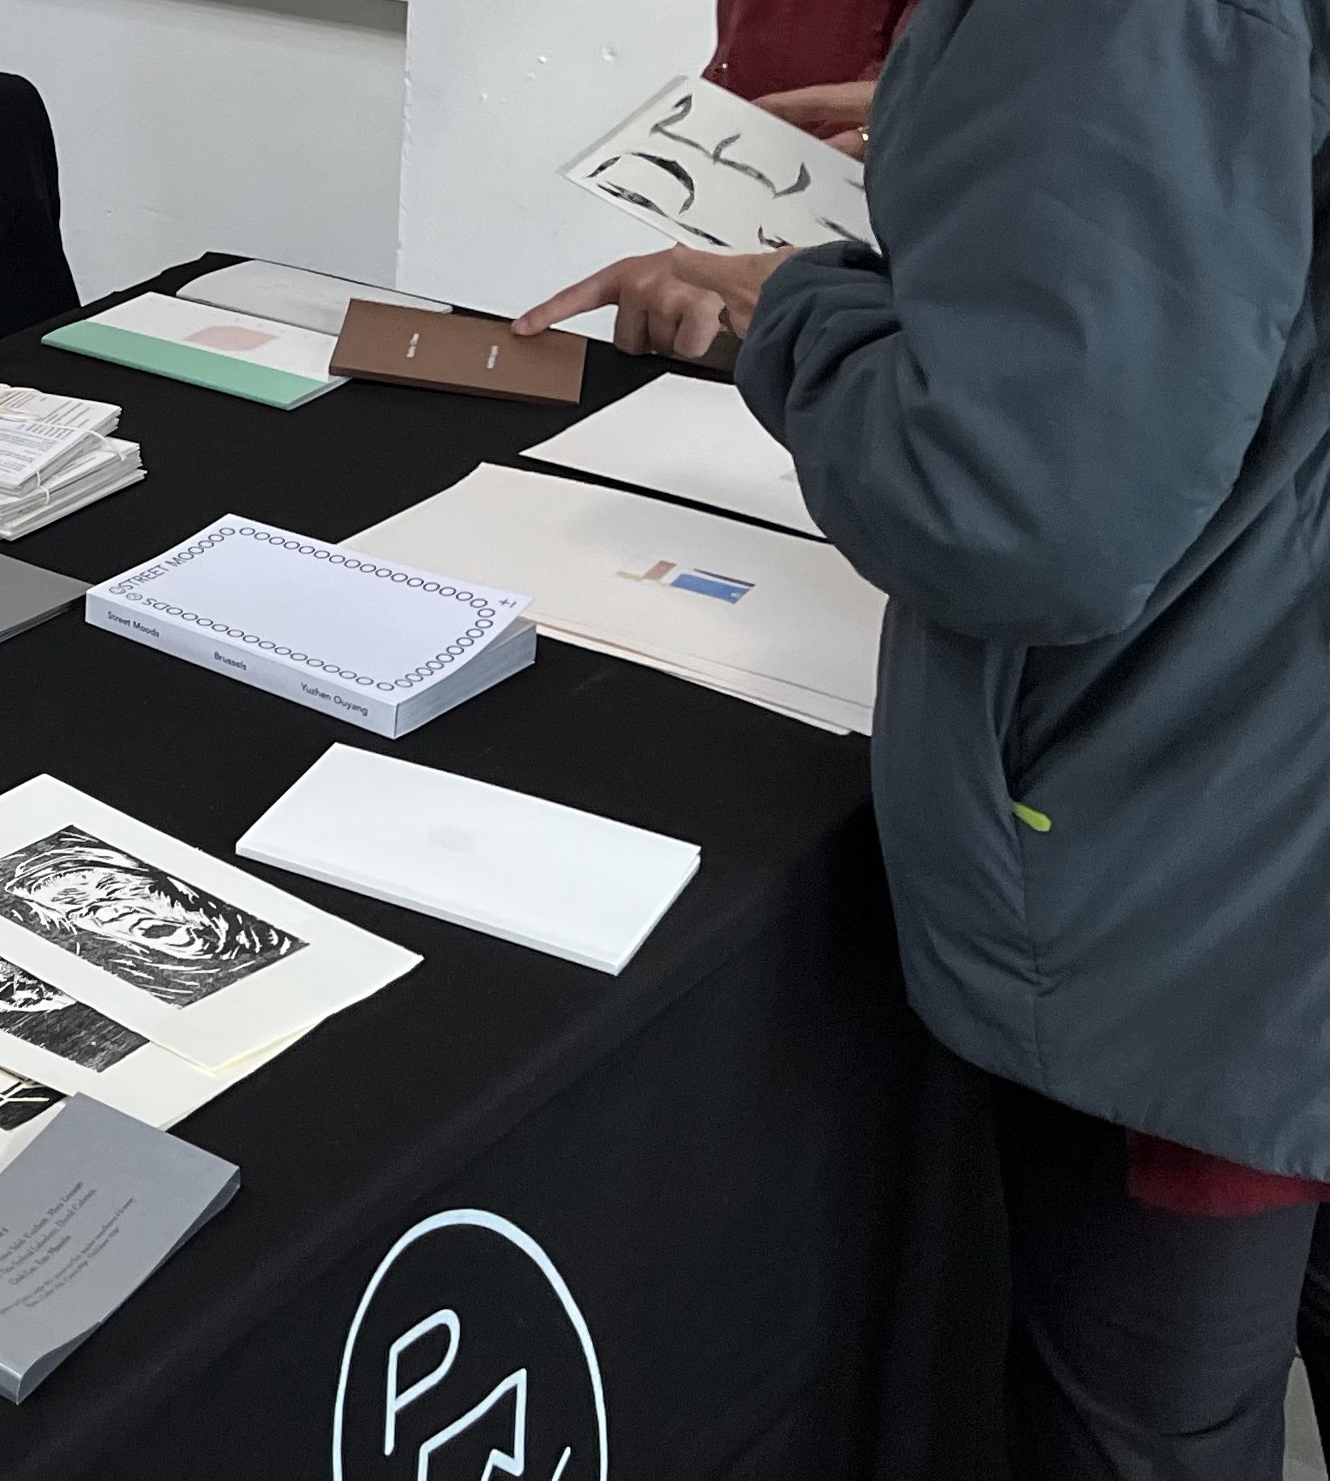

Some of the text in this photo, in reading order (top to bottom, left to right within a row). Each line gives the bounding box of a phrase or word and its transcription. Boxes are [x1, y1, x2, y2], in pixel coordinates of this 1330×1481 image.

[118, 564, 171, 591] STREET
[107, 610, 160, 638] Street Moods
[213, 650, 247, 671] Brussels
[333, 695, 369, 717] Ouyang
